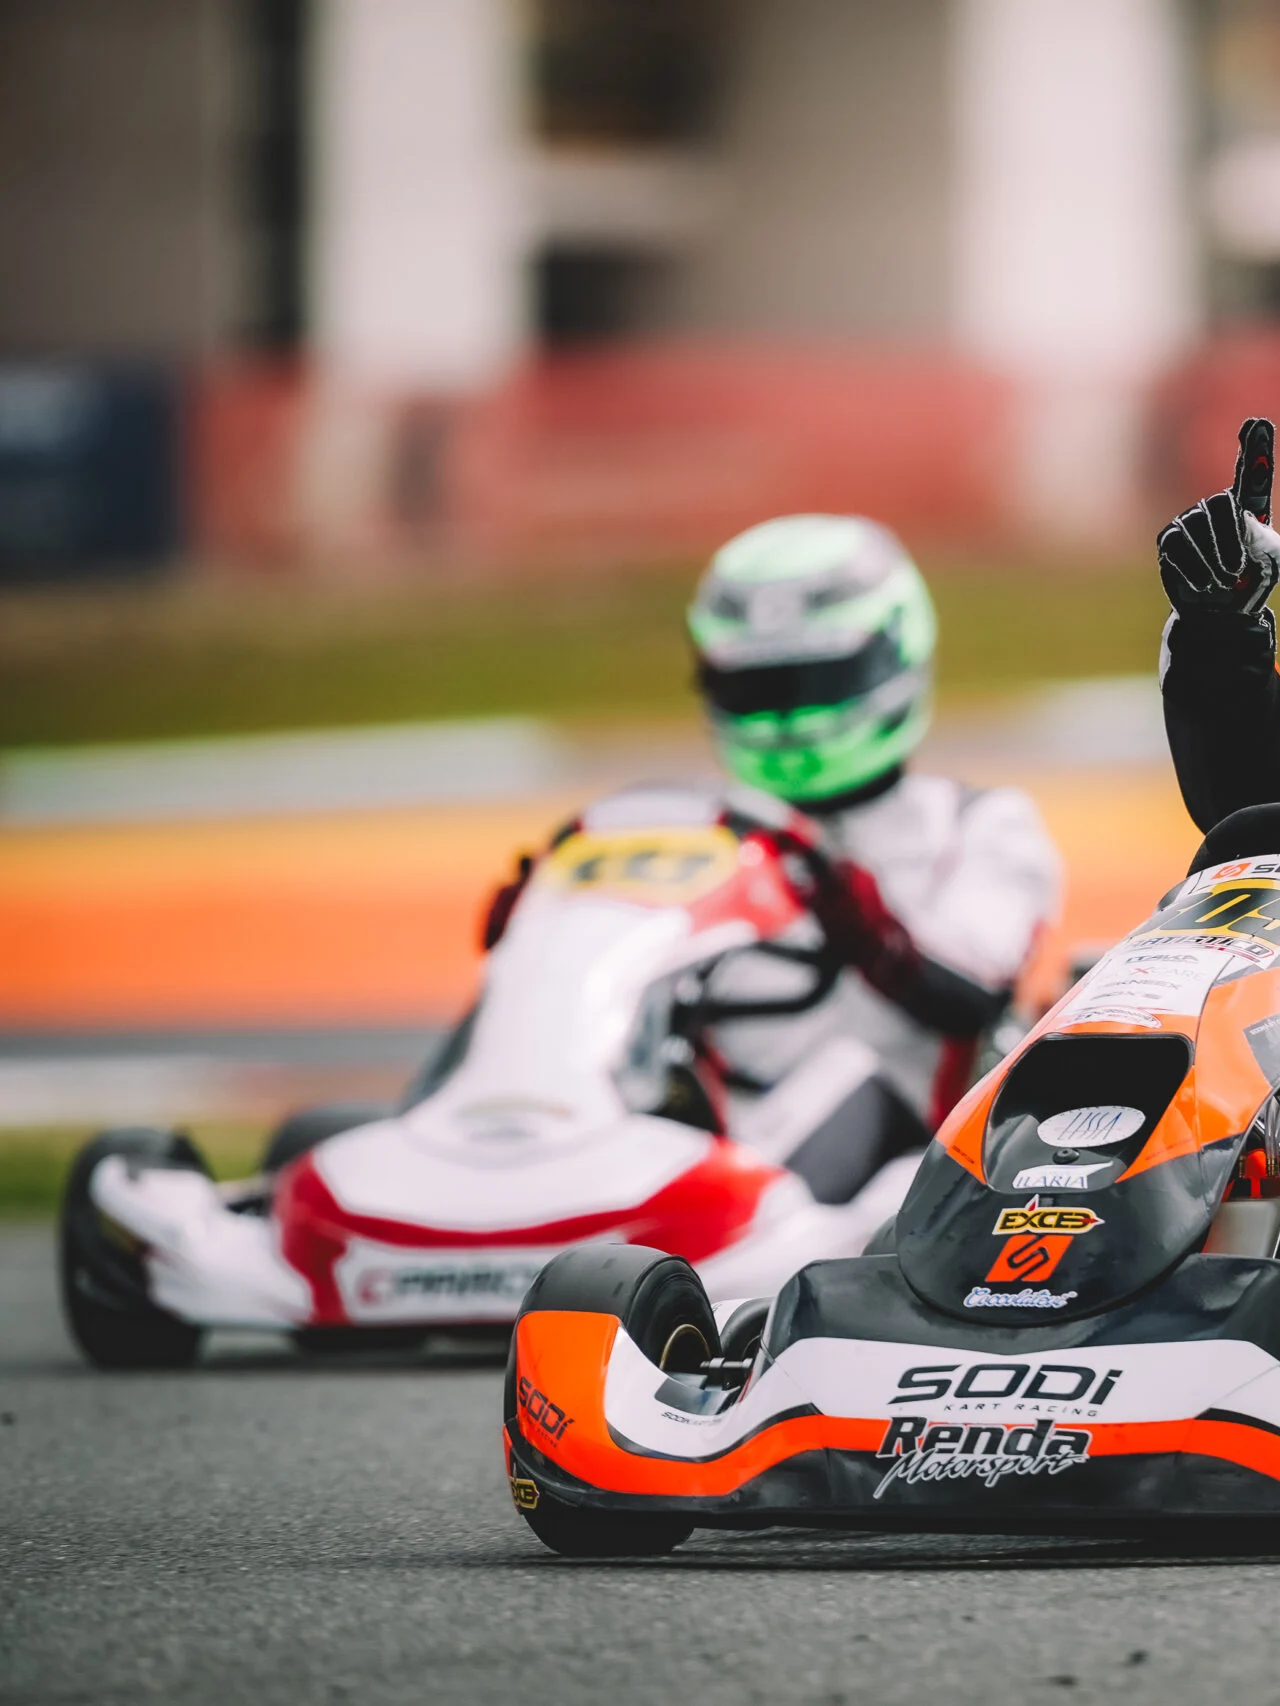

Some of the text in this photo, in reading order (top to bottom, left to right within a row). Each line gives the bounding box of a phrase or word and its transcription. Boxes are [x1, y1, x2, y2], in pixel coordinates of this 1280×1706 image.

[944, 1403, 1098, 1417] KART RACING
[876, 1415, 1092, 1458] Renda
[873, 1448, 1090, 1499] Motorsport
